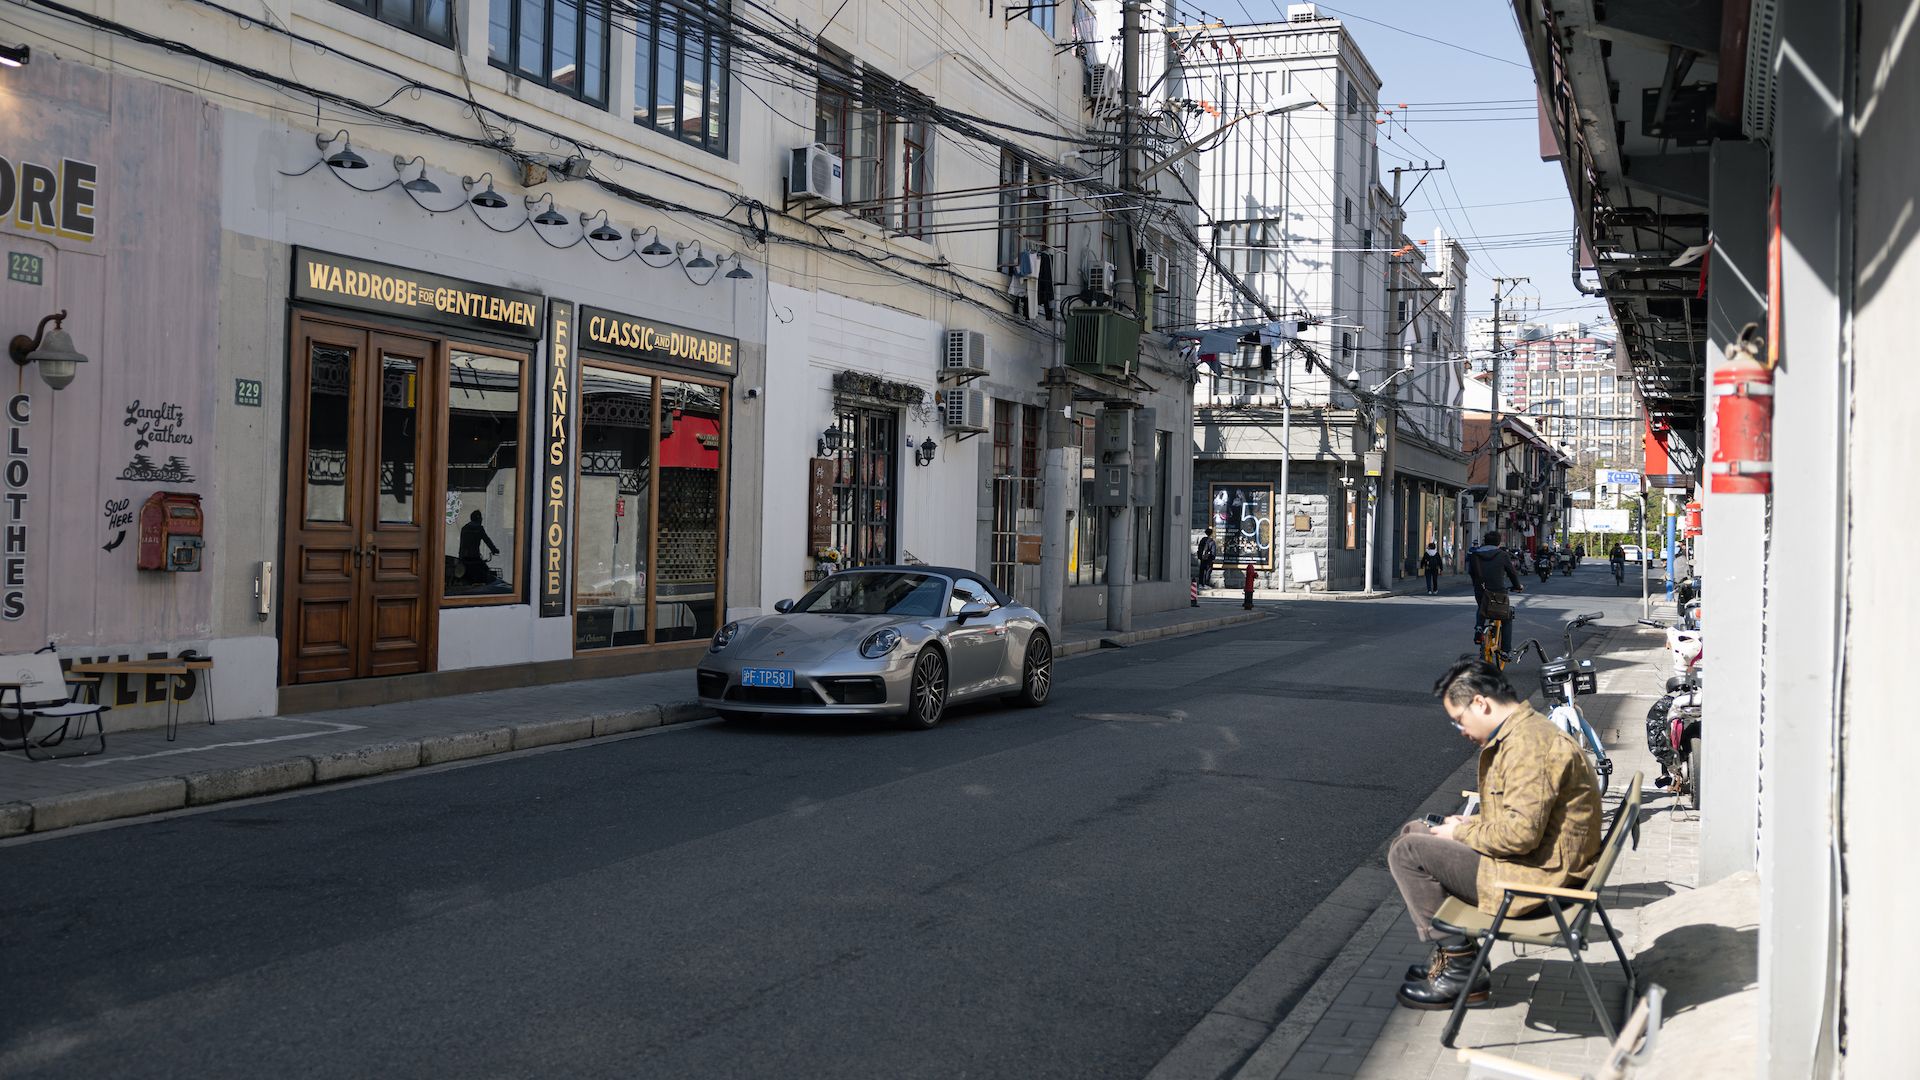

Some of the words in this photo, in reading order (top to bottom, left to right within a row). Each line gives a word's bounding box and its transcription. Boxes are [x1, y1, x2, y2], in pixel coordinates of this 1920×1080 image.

[12, 255, 39, 273] 229
[308, 262, 417, 306] WARDROBE
[419, 290, 435, 303] FOR
[435, 287, 537, 327] GENTLEMEN
[589, 316, 654, 351] CLASSIC
[654, 334, 670, 348] AND
[670, 332, 732, 366] DURABLE
[238, 382, 260, 397] 229
[550, 320, 568, 466] FRANK'S
[124, 400, 184, 427] Langlitz
[135, 422, 193, 450] Leathers
[3, 394, 30, 620] CLOTHES
[109, 512, 133, 530] HERE
[547, 475, 564, 595] STORE
